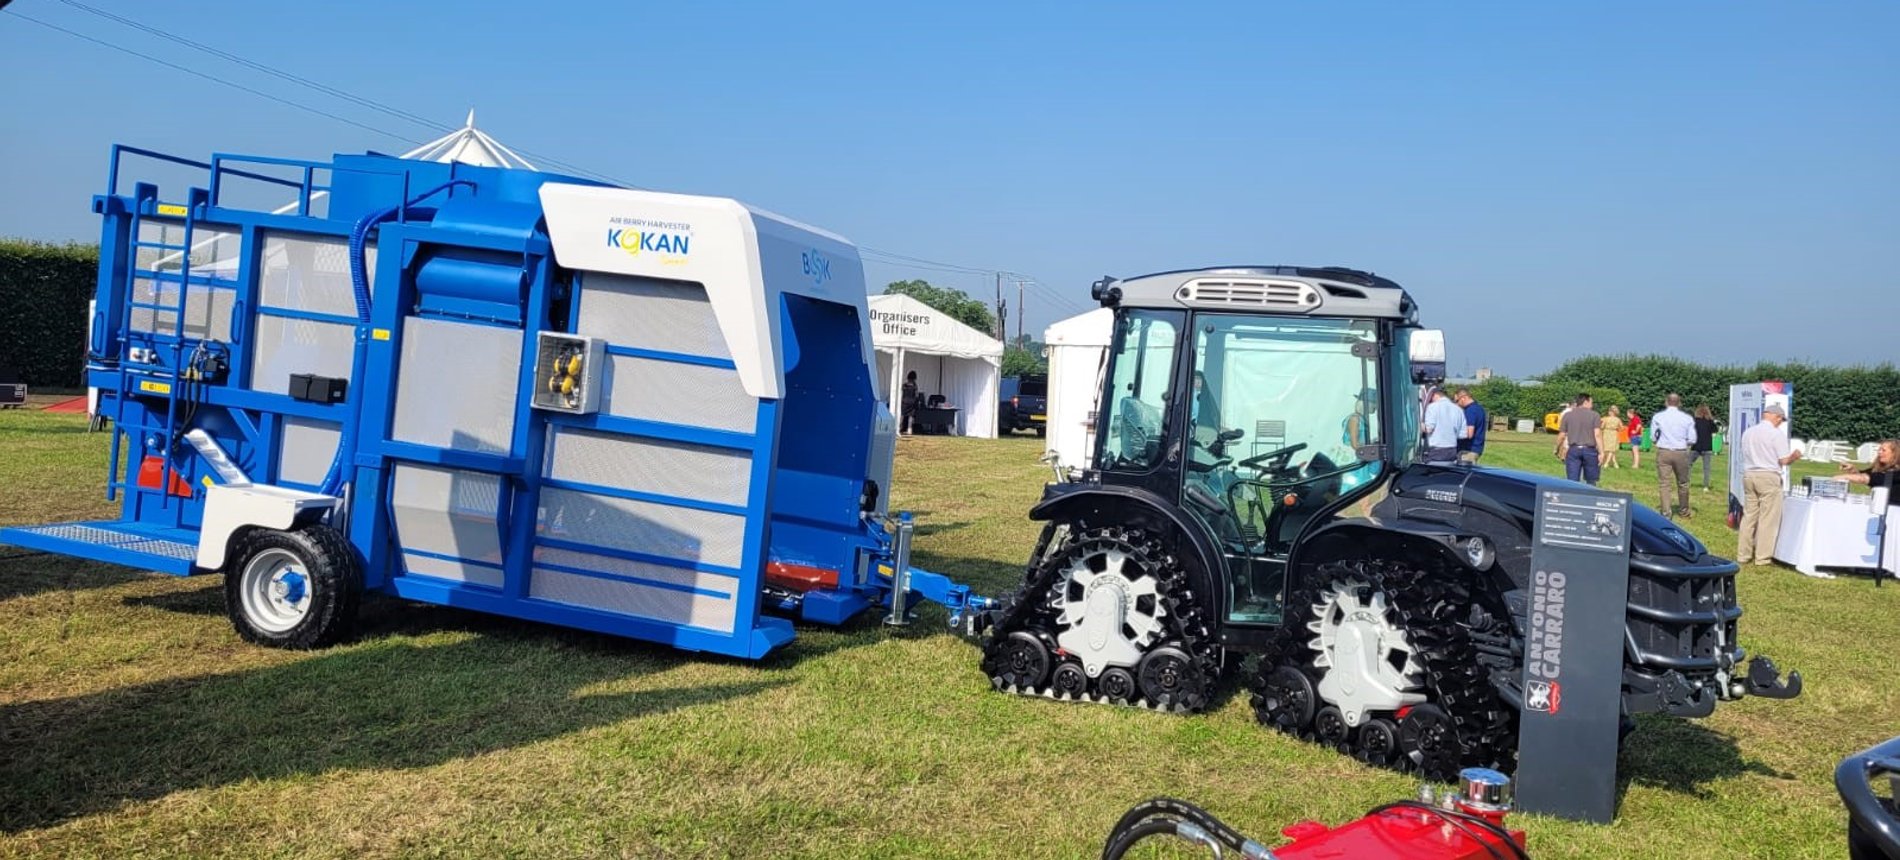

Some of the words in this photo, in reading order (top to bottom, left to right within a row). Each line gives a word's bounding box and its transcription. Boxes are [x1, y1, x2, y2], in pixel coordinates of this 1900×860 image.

[623, 218, 646, 226] BERRY
[647, 219, 691, 231] HARVESTER
[607, 228, 689, 255] KOKAN
[869, 309, 930, 325] Organisers
[883, 323, 916, 336] Office
[1529, 570, 1547, 677] ANTONIO
[1542, 572, 1566, 679] CARRARO
